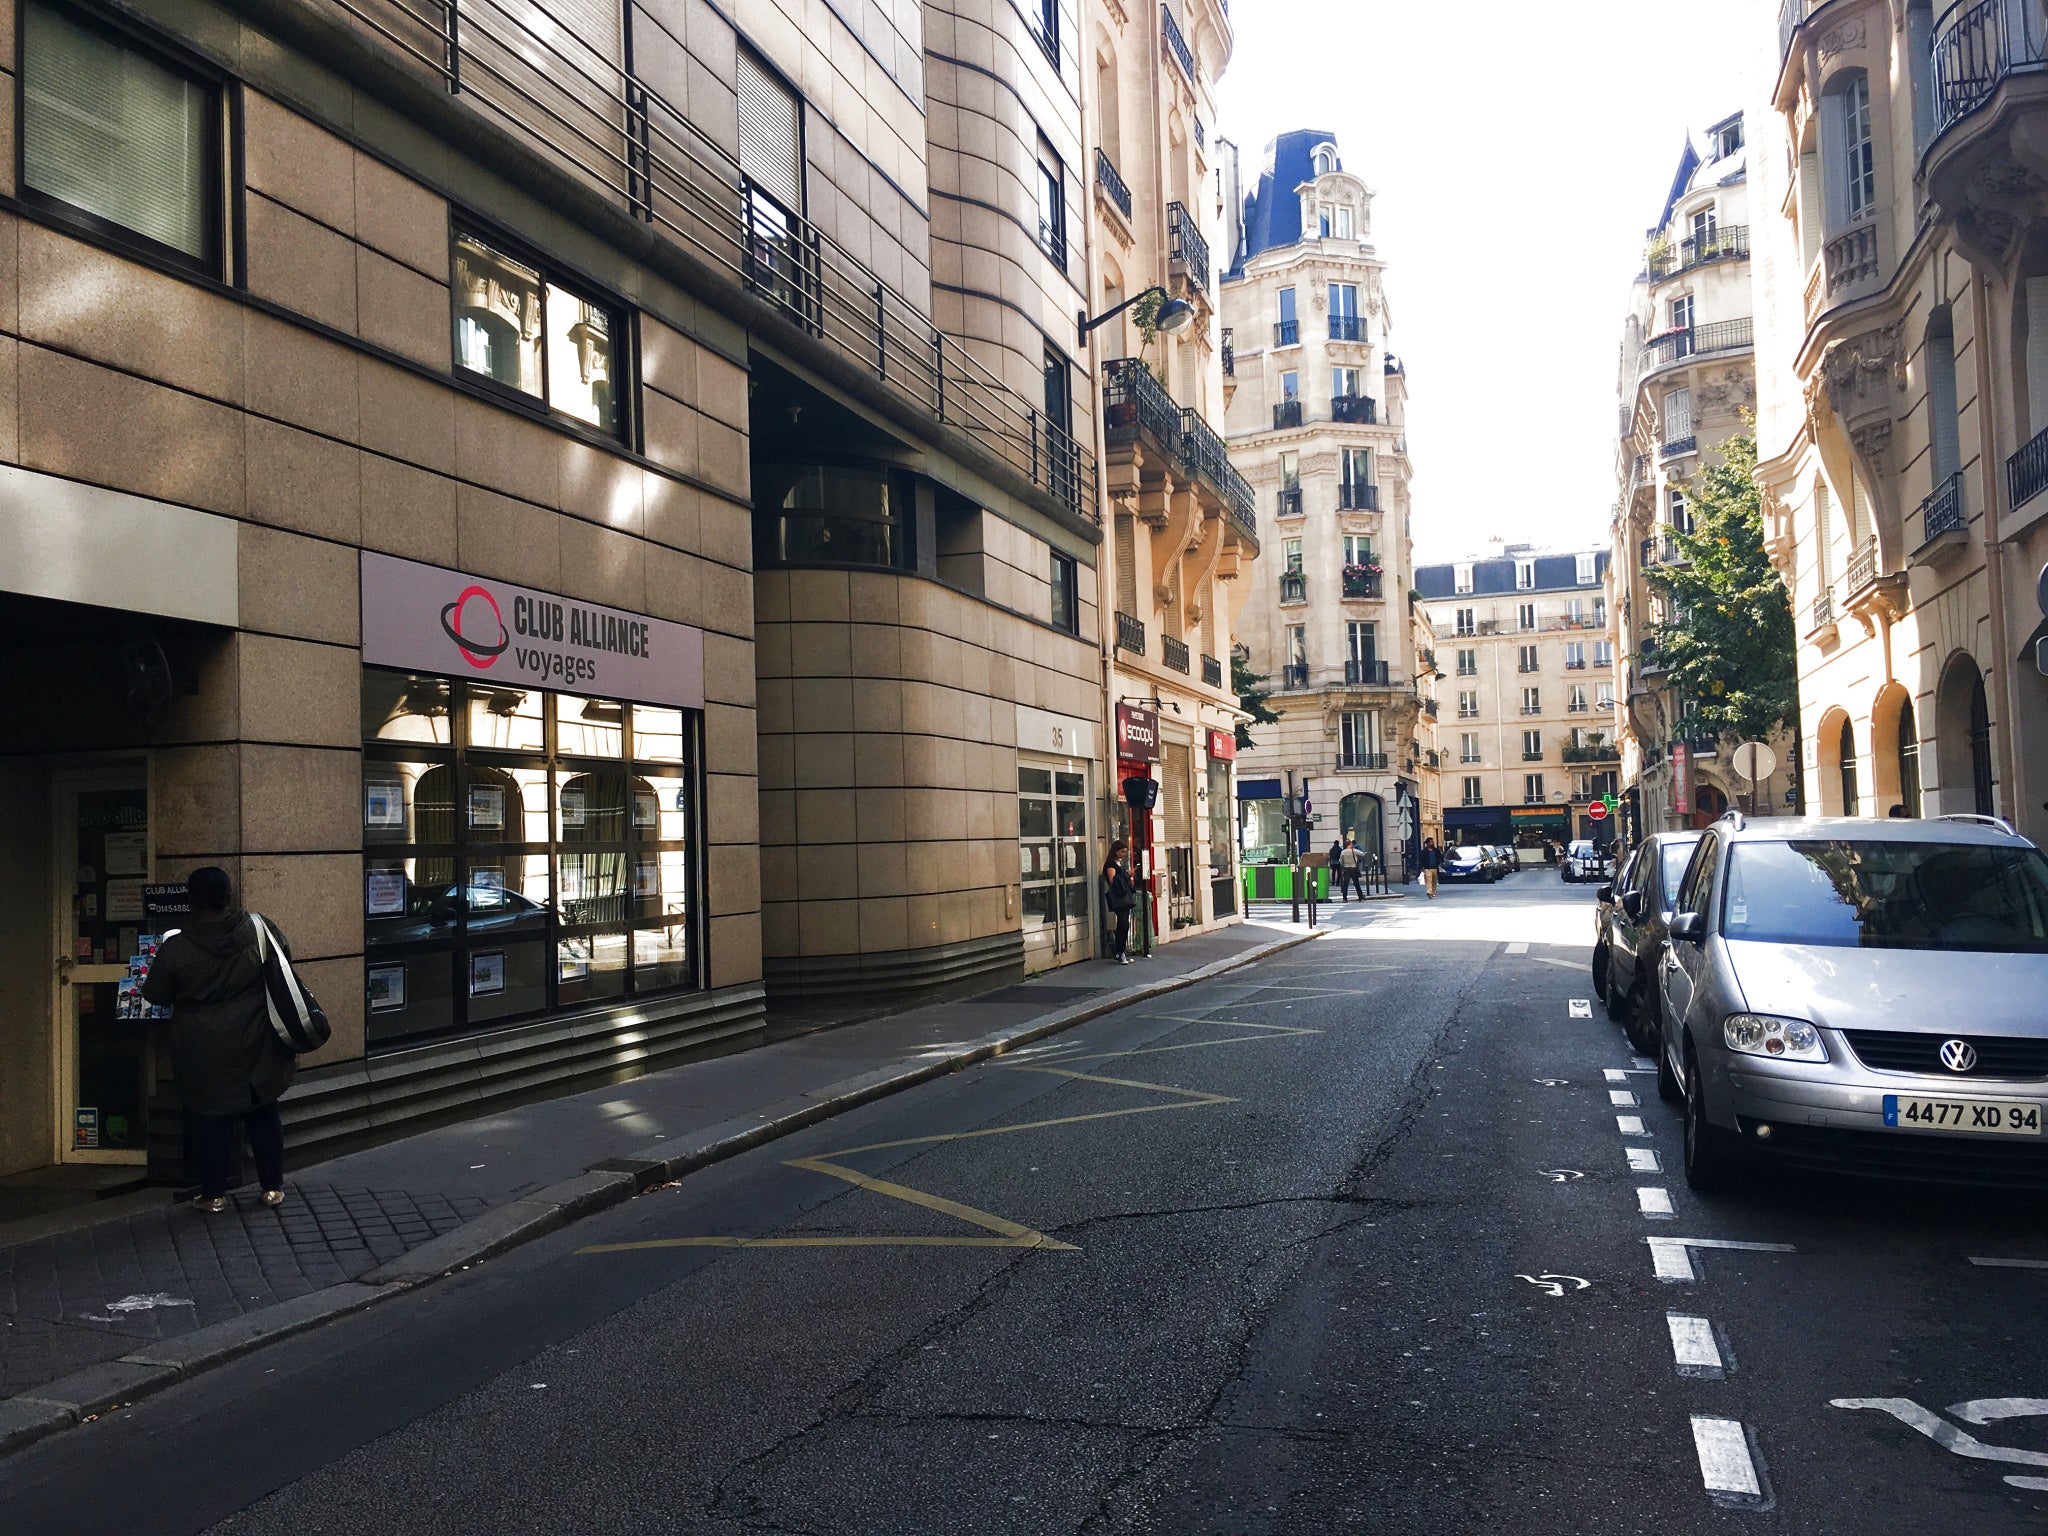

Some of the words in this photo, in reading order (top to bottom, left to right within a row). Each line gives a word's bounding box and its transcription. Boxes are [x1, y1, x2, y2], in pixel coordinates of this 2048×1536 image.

[514, 595, 564, 642] CLUB
[570, 607, 650, 659] ALLIANCE
[515, 647, 596, 685] voyages
[1052, 727, 1064, 748] 35
[145, 887, 166, 895] CLUB
[1905, 1101, 1964, 1126] 4477
[1972, 1105, 2001, 1128] XD
[2009, 1107, 2038, 1130] 94
